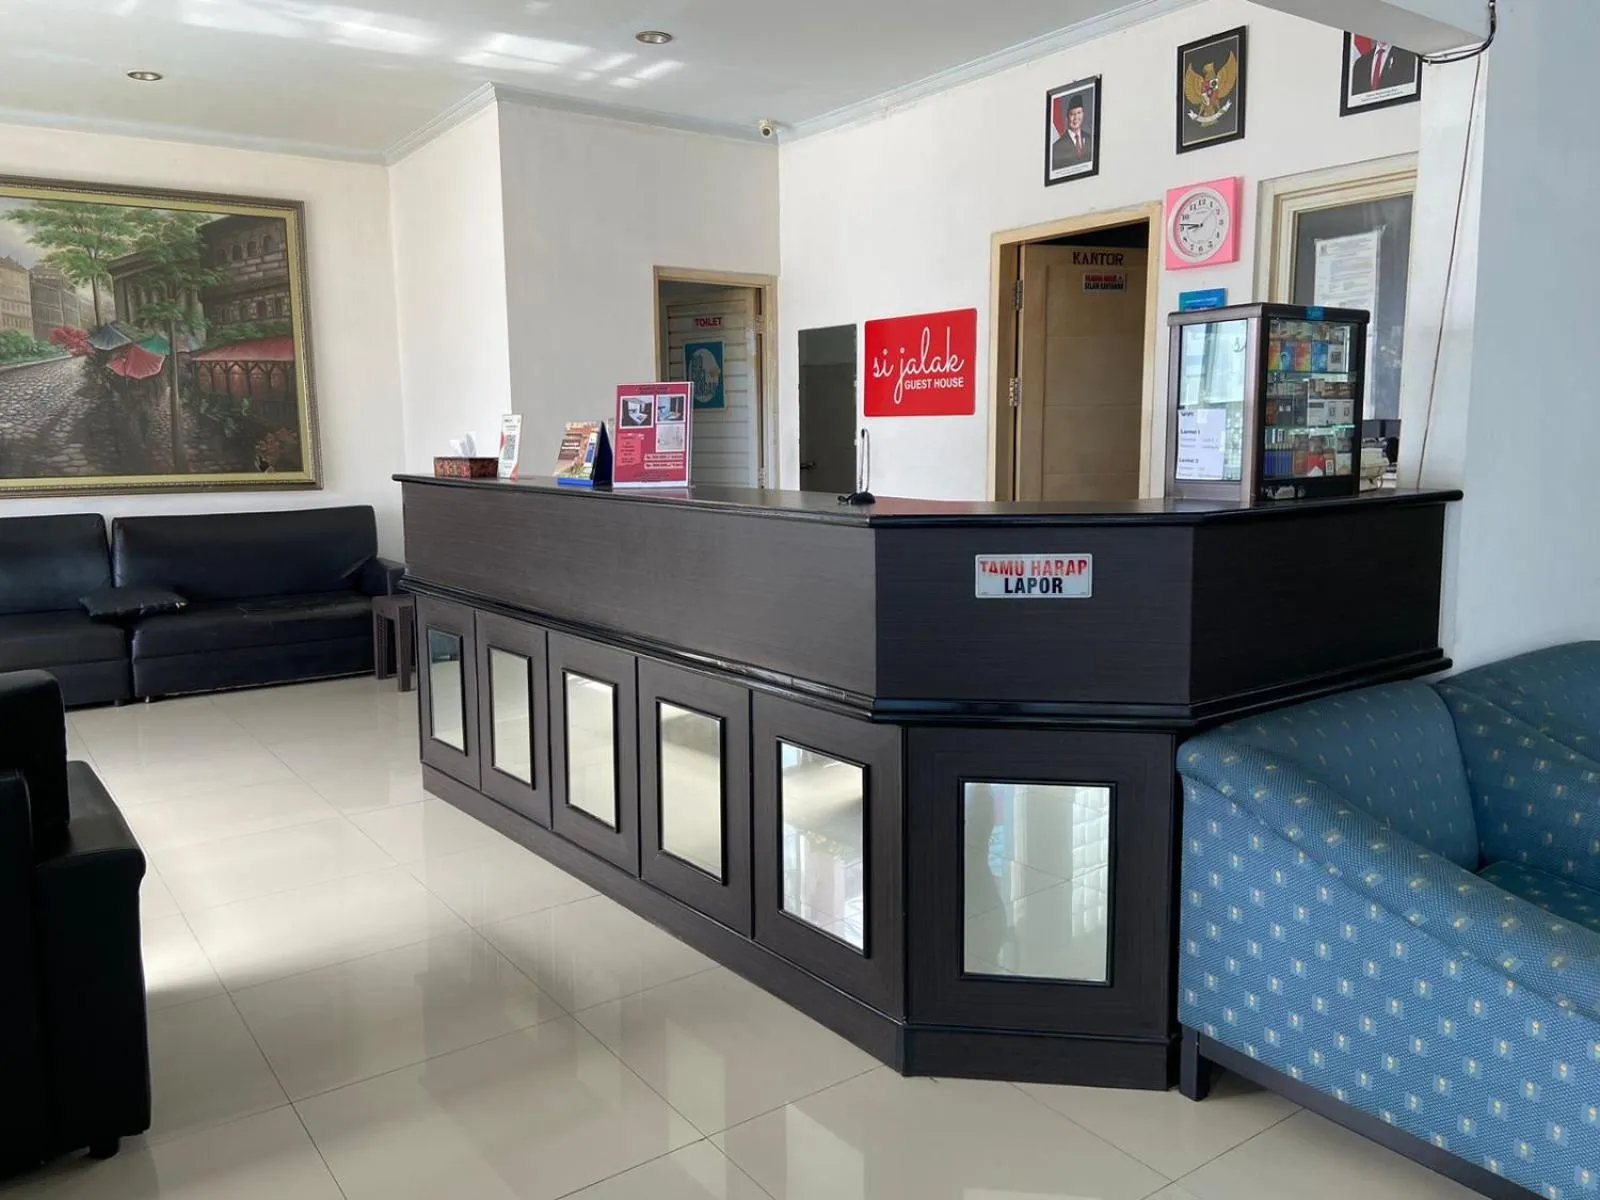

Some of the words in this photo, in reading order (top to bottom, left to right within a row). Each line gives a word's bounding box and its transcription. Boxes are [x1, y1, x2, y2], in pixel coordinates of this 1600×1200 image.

[1189, 203, 1197, 211] 11
[1198, 198, 1206, 206] 12
[1073, 252, 1124, 265] KANTOR
[694, 316, 722, 328] TOILET
[873, 347, 895, 378] si
[893, 326, 965, 405] jalak
[904, 378, 932, 391] GUEST
[933, 376, 965, 389] HOUSE
[979, 560, 1025, 576] TAMU
[1031, 560, 1087, 576] HARAP
[1004, 577, 1063, 594] LAPOR
